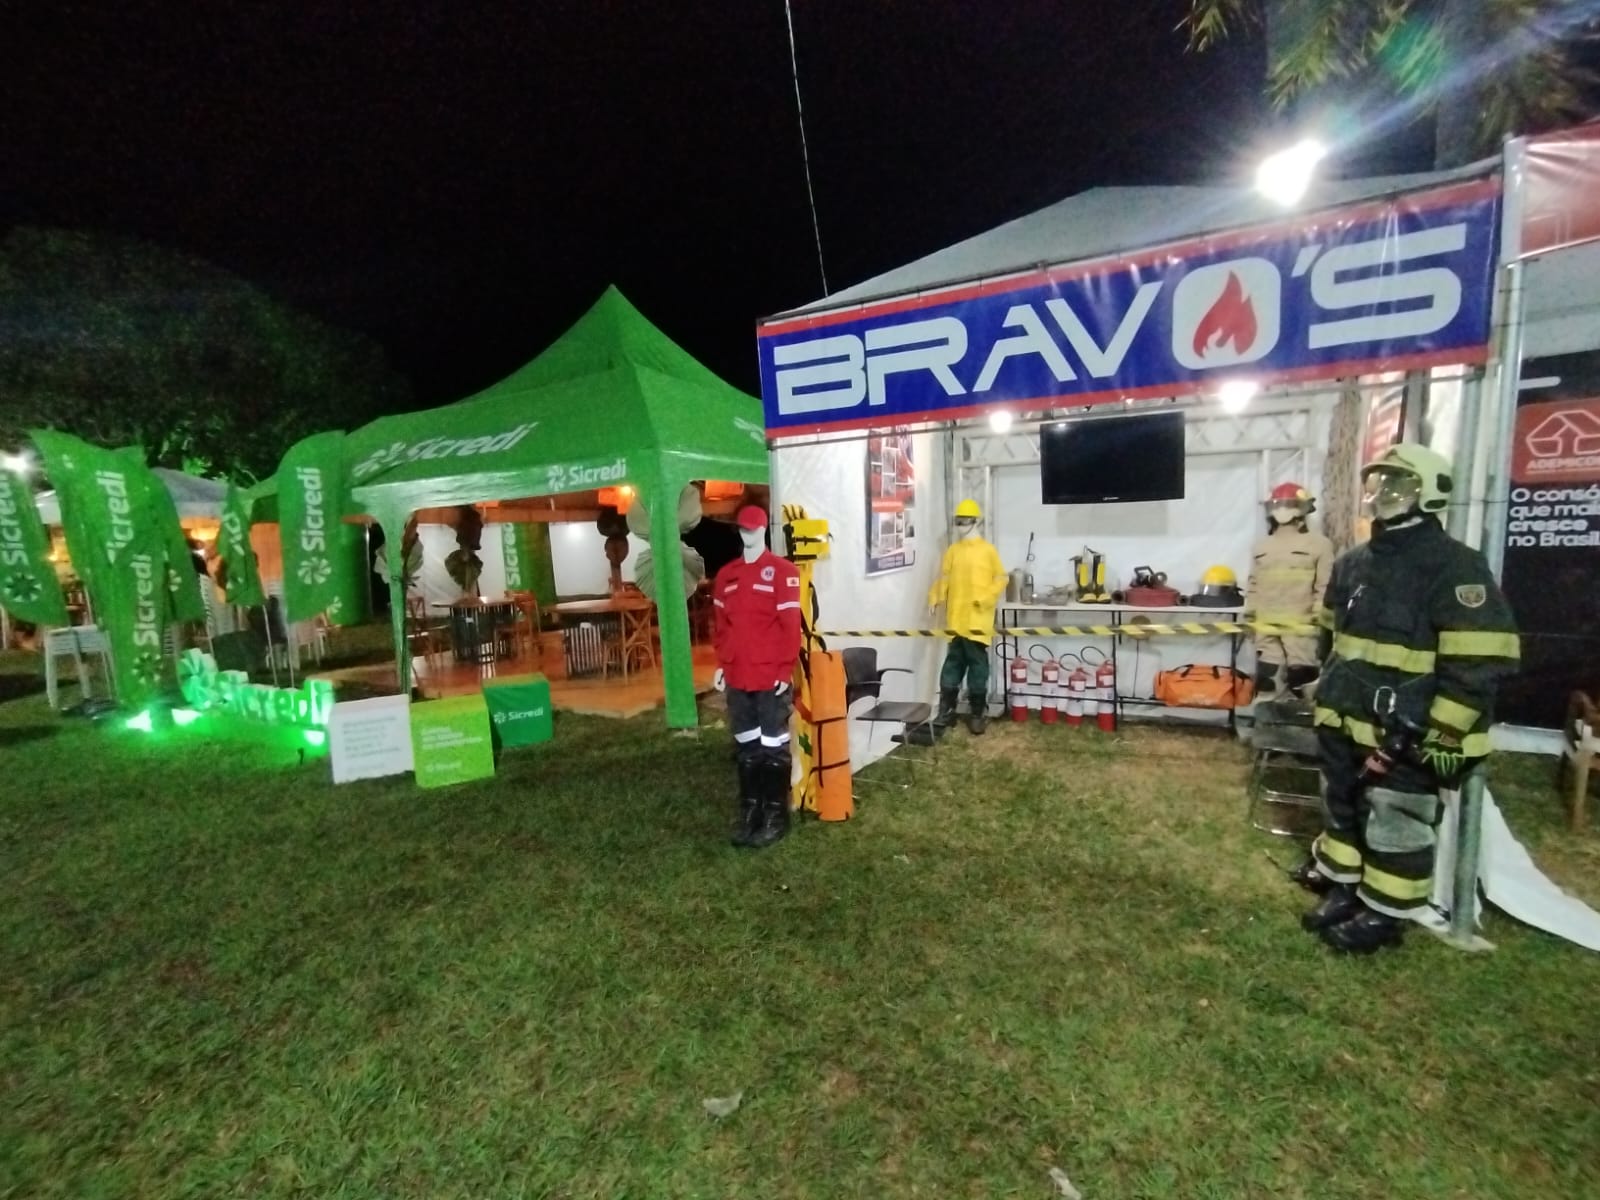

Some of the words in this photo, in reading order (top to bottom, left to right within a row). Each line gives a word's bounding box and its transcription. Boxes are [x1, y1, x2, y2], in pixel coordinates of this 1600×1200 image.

[773, 222, 1467, 416] BRAVO'S
[405, 421, 539, 463] Sicredi
[568, 458, 627, 486] Sicredi
[1511, 488, 1531, 502] O
[1532, 484, 1600, 502] consó
[296, 466, 325, 552] Sicredi
[1509, 504, 1551, 520] que
[1553, 501, 1600, 516] mai
[1508, 519, 1589, 531] cresce
[1508, 535, 1537, 546] no
[129, 553, 160, 647] Sicredi
[507, 707, 544, 721] Sicredi
